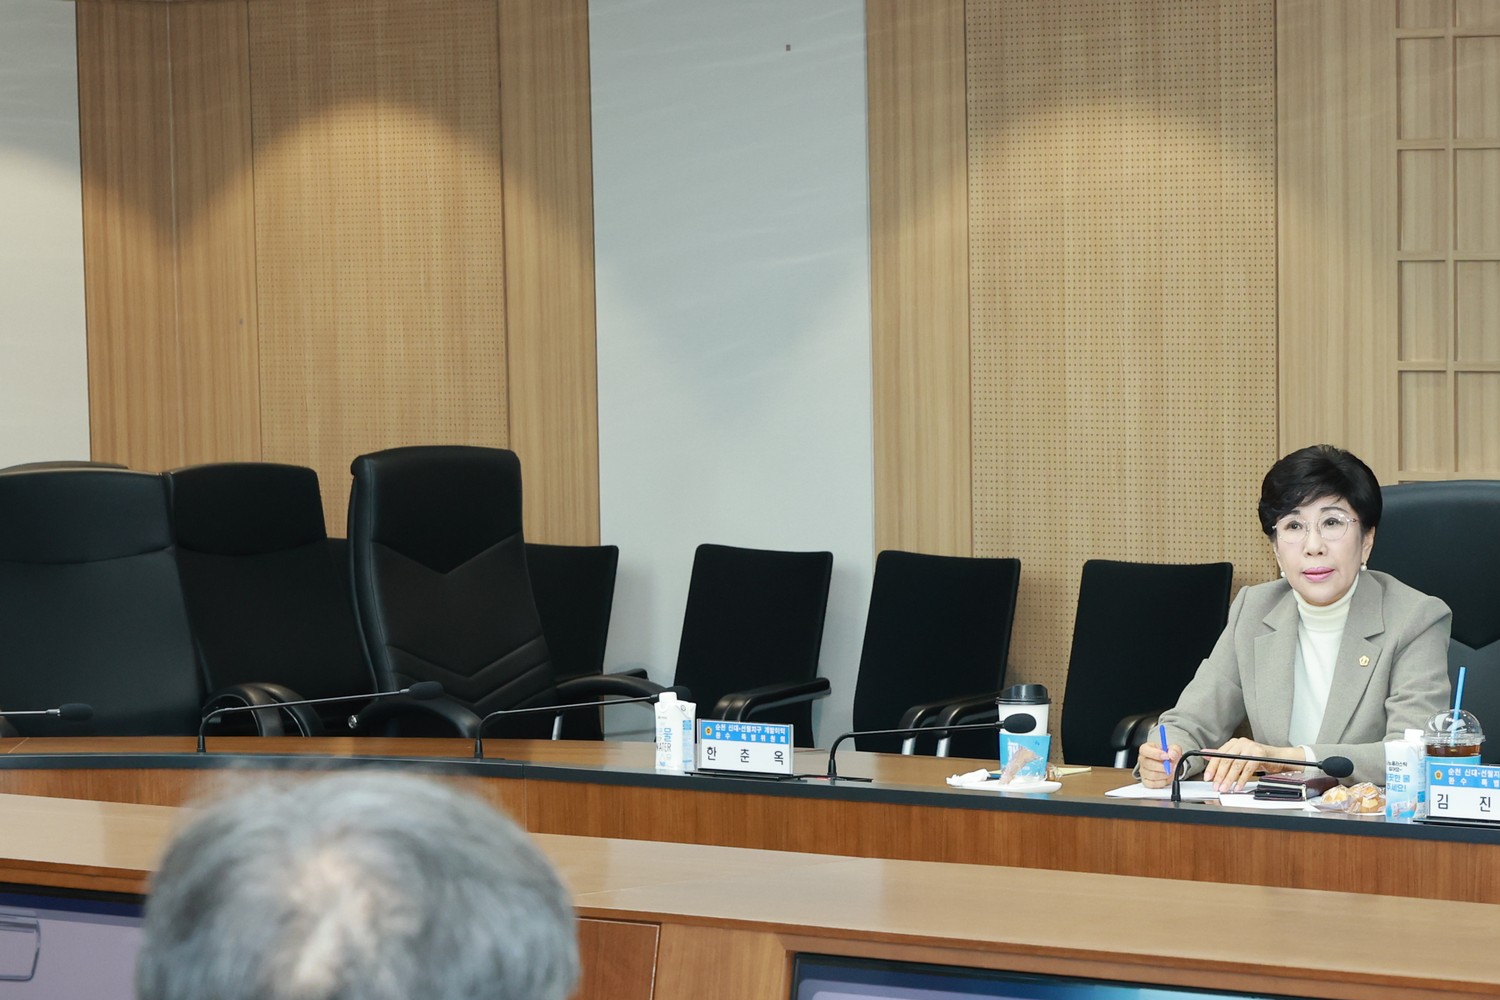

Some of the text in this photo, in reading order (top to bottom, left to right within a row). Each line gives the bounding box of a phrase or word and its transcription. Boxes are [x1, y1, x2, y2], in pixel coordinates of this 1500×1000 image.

[715, 723, 726, 731] 순천
[764, 726, 786, 735] 개발이익
[1448, 767, 1461, 776] 순천
[1386, 773, 1400, 782] 끗한
